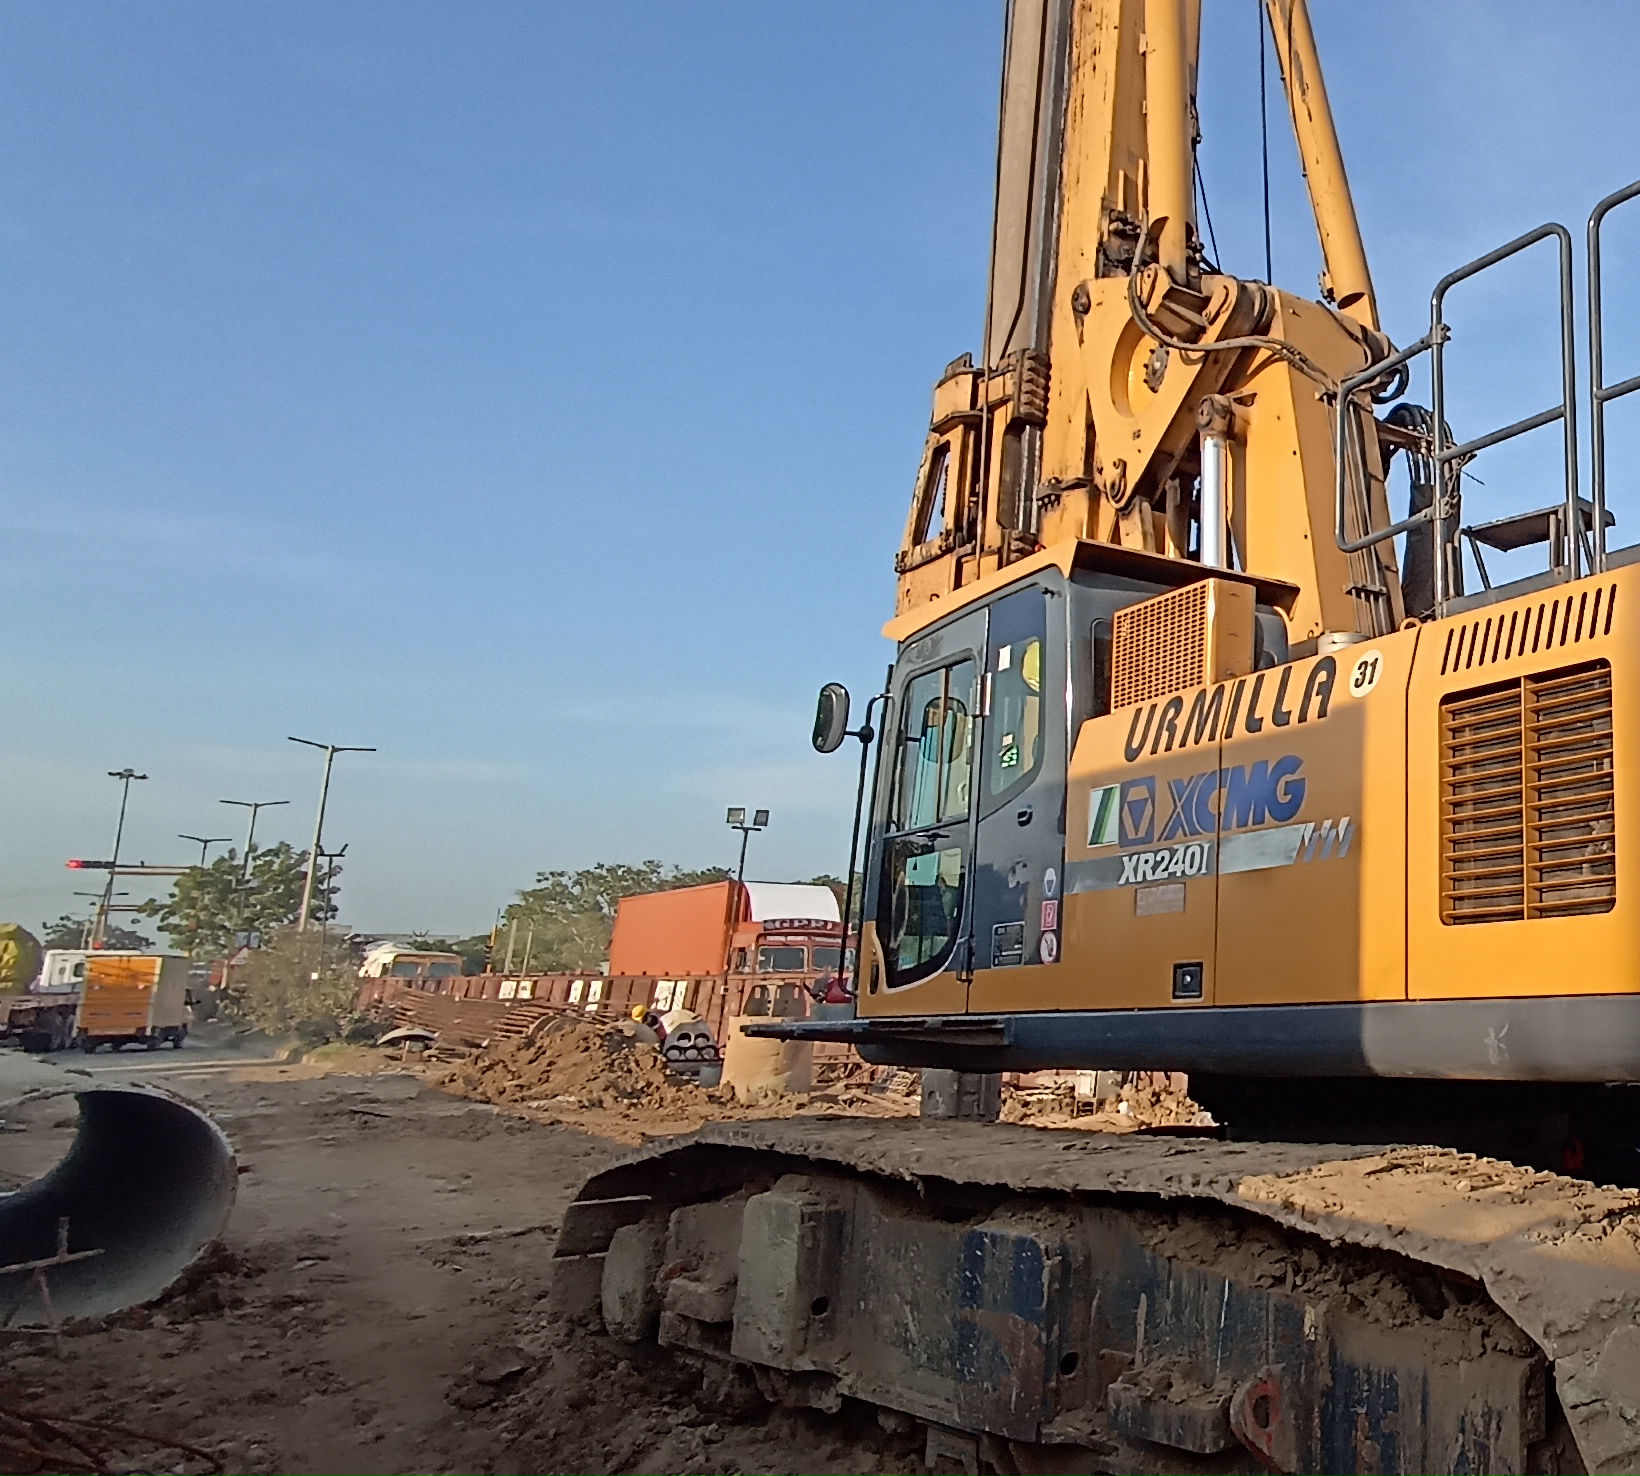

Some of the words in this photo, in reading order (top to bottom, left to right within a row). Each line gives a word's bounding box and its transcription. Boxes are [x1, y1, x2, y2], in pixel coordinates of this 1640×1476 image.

[1123, 655, 1337, 763] URMILLA
[1354, 657, 1379, 689] 31
[1157, 754, 1307, 843] XCMG
